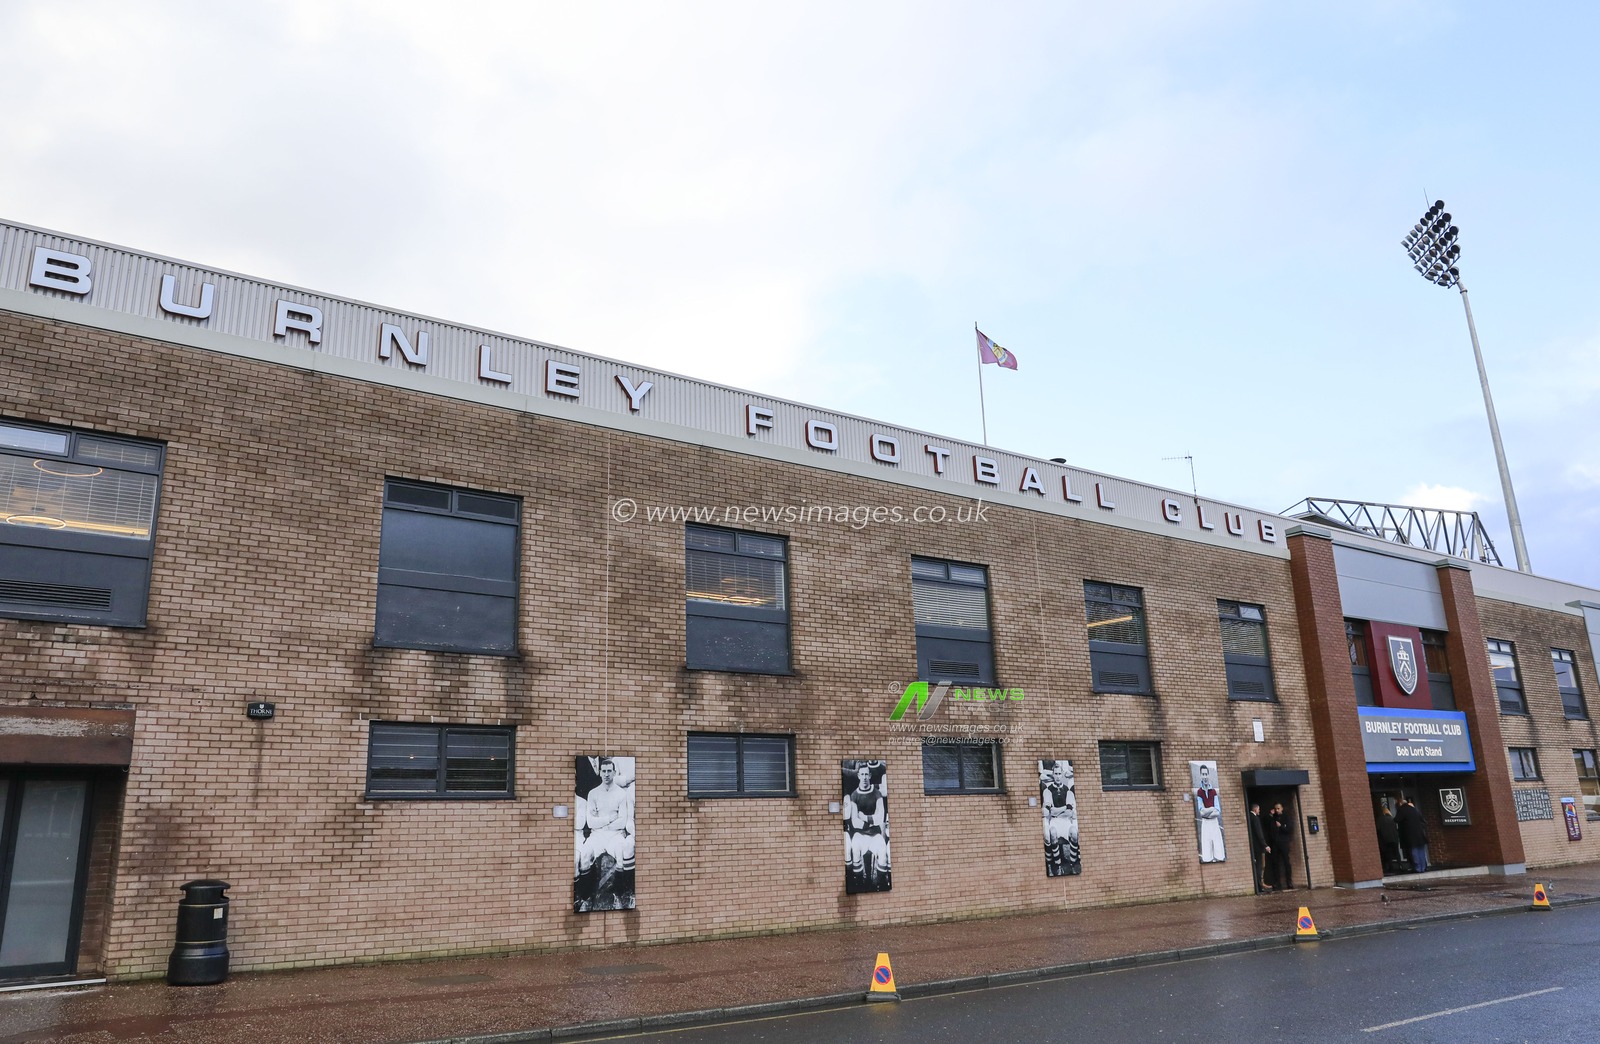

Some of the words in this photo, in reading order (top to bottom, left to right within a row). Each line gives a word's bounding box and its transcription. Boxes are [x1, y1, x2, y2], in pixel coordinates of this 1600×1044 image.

[30, 246, 653, 411] BURNLEY
[746, 404, 1115, 510] FOOTBALL
[1162, 498, 1277, 543] CLUB
[1365, 721, 1402, 734] BURNLEY
[1404, 722, 1441, 735] FOOTBALL
[1442, 724, 1462, 736] CLUB
[1396, 746, 1410, 756] Bob
[1409, 746, 1424, 756] Lord
[1424, 746, 1443, 757] Stand
